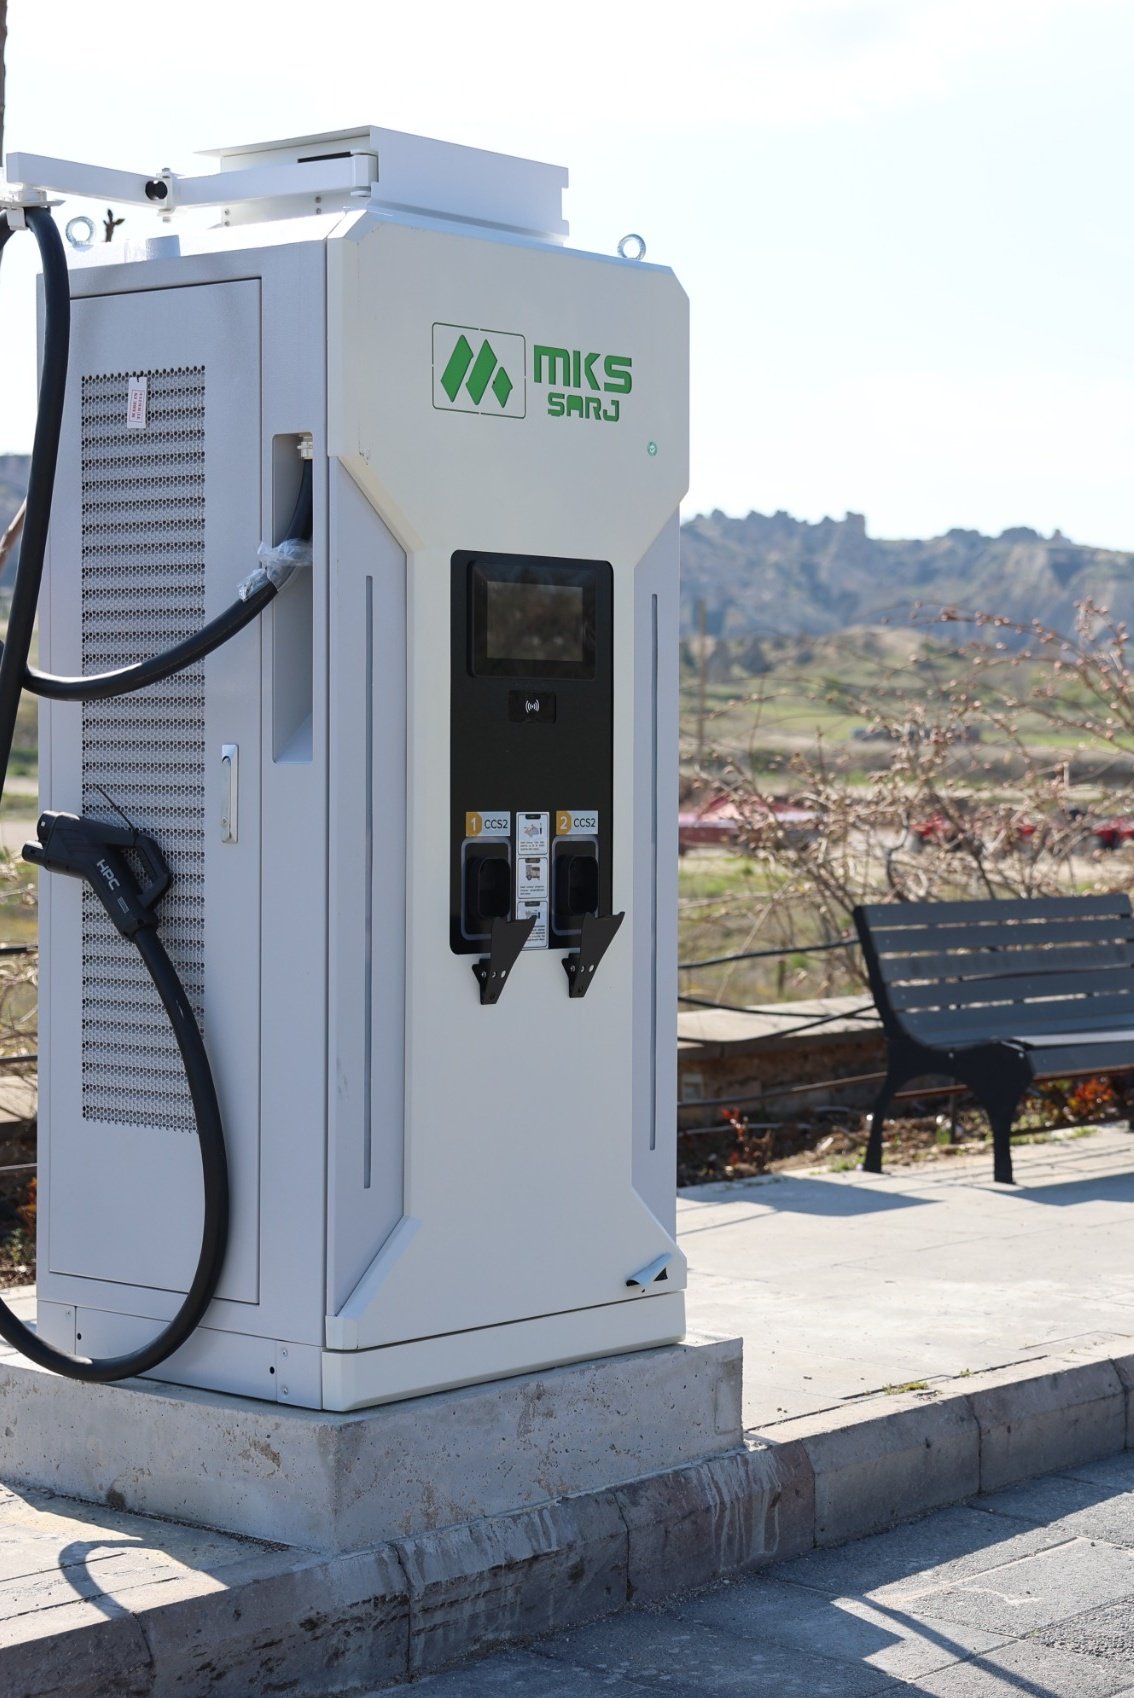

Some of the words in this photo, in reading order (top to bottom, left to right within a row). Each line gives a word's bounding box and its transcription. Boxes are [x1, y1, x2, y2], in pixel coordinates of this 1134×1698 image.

[533, 344, 633, 394] MKS
[470, 817, 477, 831] 1
[484, 819, 508, 830] CCS2
[559, 815, 567, 830] 2
[573, 817, 596, 828] CCS2
[96, 858, 121, 891] HPC
